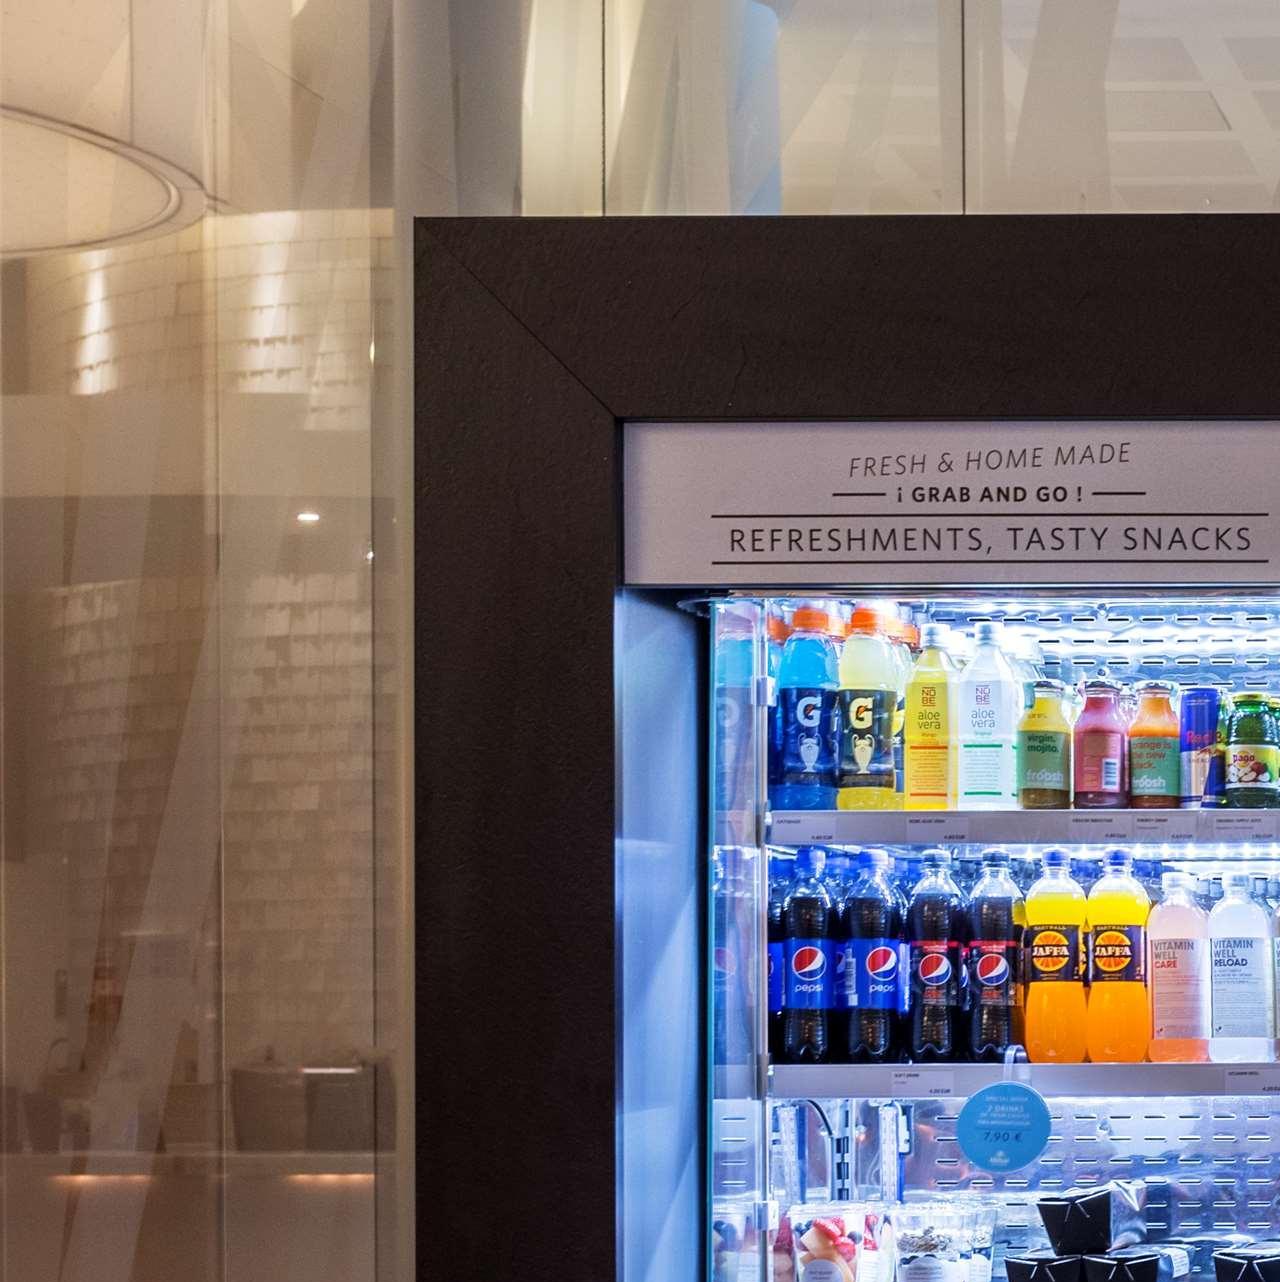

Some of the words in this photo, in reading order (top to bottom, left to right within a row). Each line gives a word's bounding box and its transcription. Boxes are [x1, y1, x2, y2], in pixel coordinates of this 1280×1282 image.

[850, 453, 927, 478] FRESH
[937, 452, 954, 473] &
[965, 447, 1044, 471] HOME
[1054, 442, 1131, 467] MADE
[911, 486, 971, 503] GRAB
[979, 486, 1027, 502] AND
[1036, 486, 1068, 502] GO
[729, 527, 993, 555] REFRESHMENTS,
[1006, 526, 1109, 551] TASTY
[1123, 526, 1252, 551] SNACKS
[918, 710, 941, 721] aloe
[971, 708, 996, 719] aloe
[918, 721, 941, 731] vera
[971, 719, 996, 729] vera
[1154, 941, 1195, 951] VITAMIN
[1213, 940, 1254, 950] VITAMIN
[1032, 945, 1070, 957] JAFFA
[1094, 945, 1132, 957] JAFFA
[1154, 951, 1179, 960] WELL
[1214, 950, 1237, 959] WELL
[1154, 960, 1178, 969] CARE
[1214, 958, 1249, 968] RELOAD
[794, 984, 824, 994] pepsi
[868, 984, 896, 994] peps
